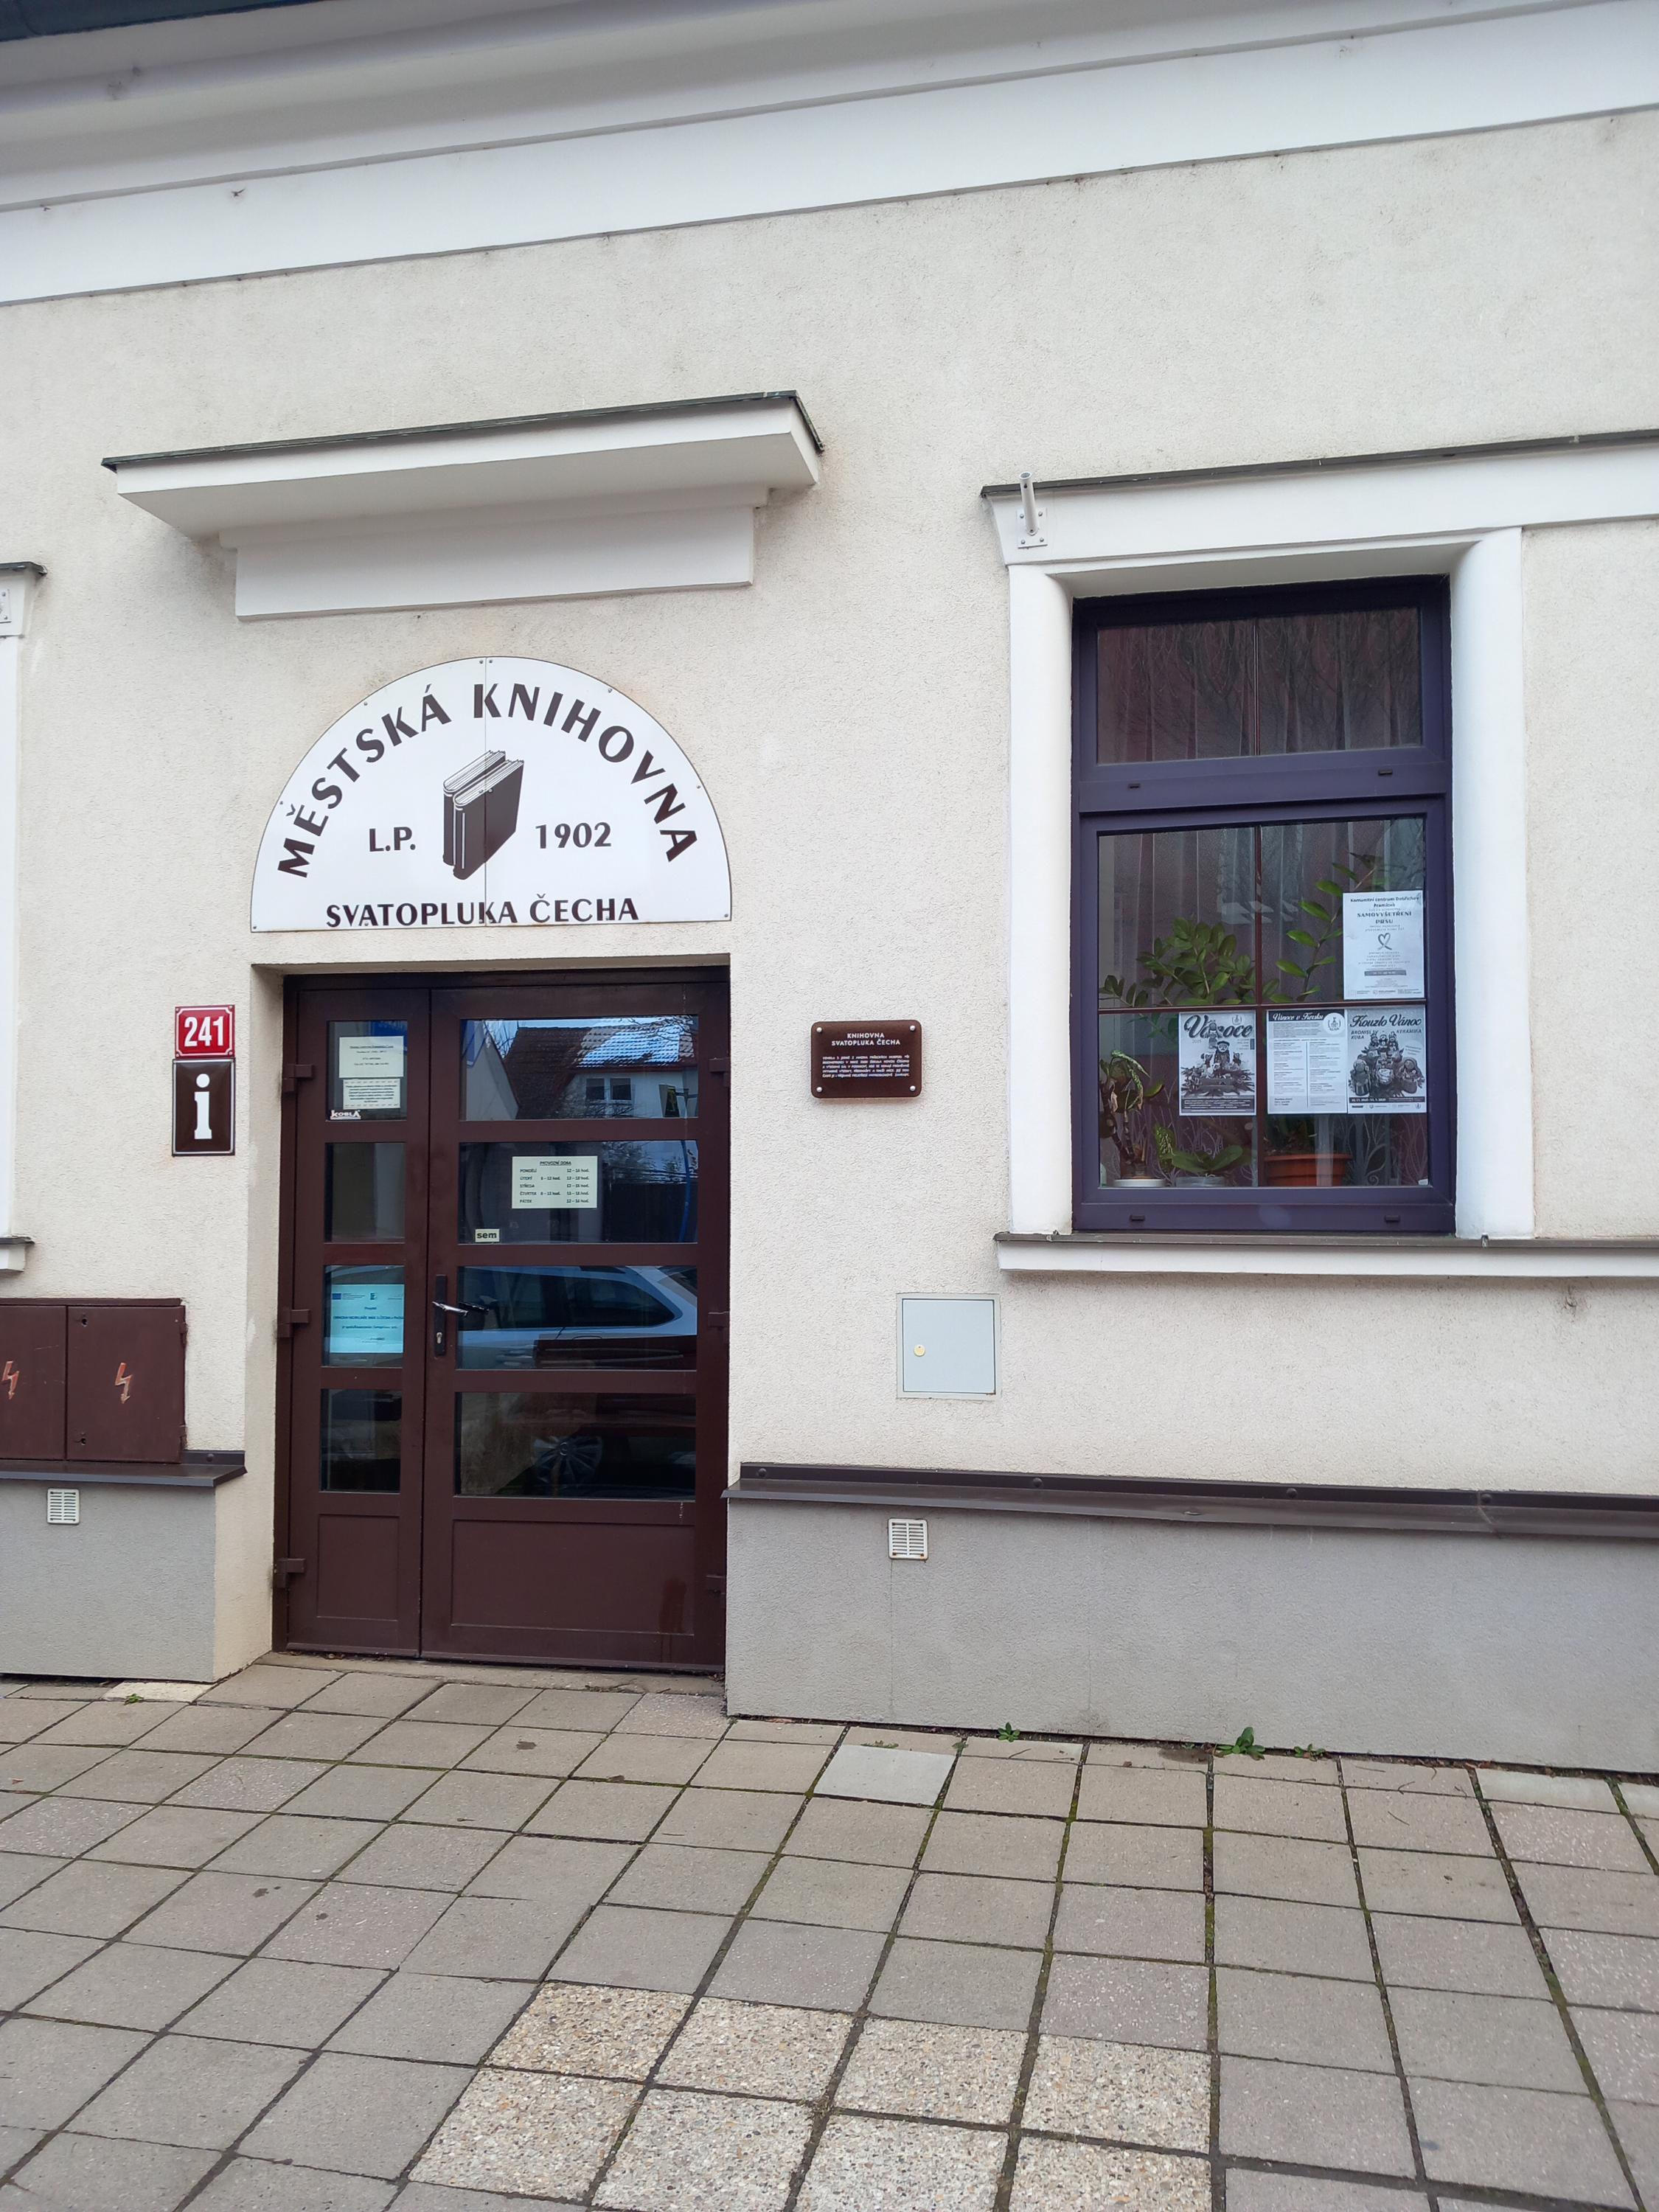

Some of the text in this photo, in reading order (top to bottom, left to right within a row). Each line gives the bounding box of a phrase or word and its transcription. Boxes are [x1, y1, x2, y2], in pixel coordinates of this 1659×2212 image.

[277, 683, 698, 878] MĚSTSKÁ KNIHOVNA
[369, 822, 612, 852] L.P. 1902
[325, 893, 639, 928] SVATOPLUKA ČECHA
[184, 1016, 224, 1047] 241
[1350, 1014, 1422, 1027] Kouzlo Vánoc
